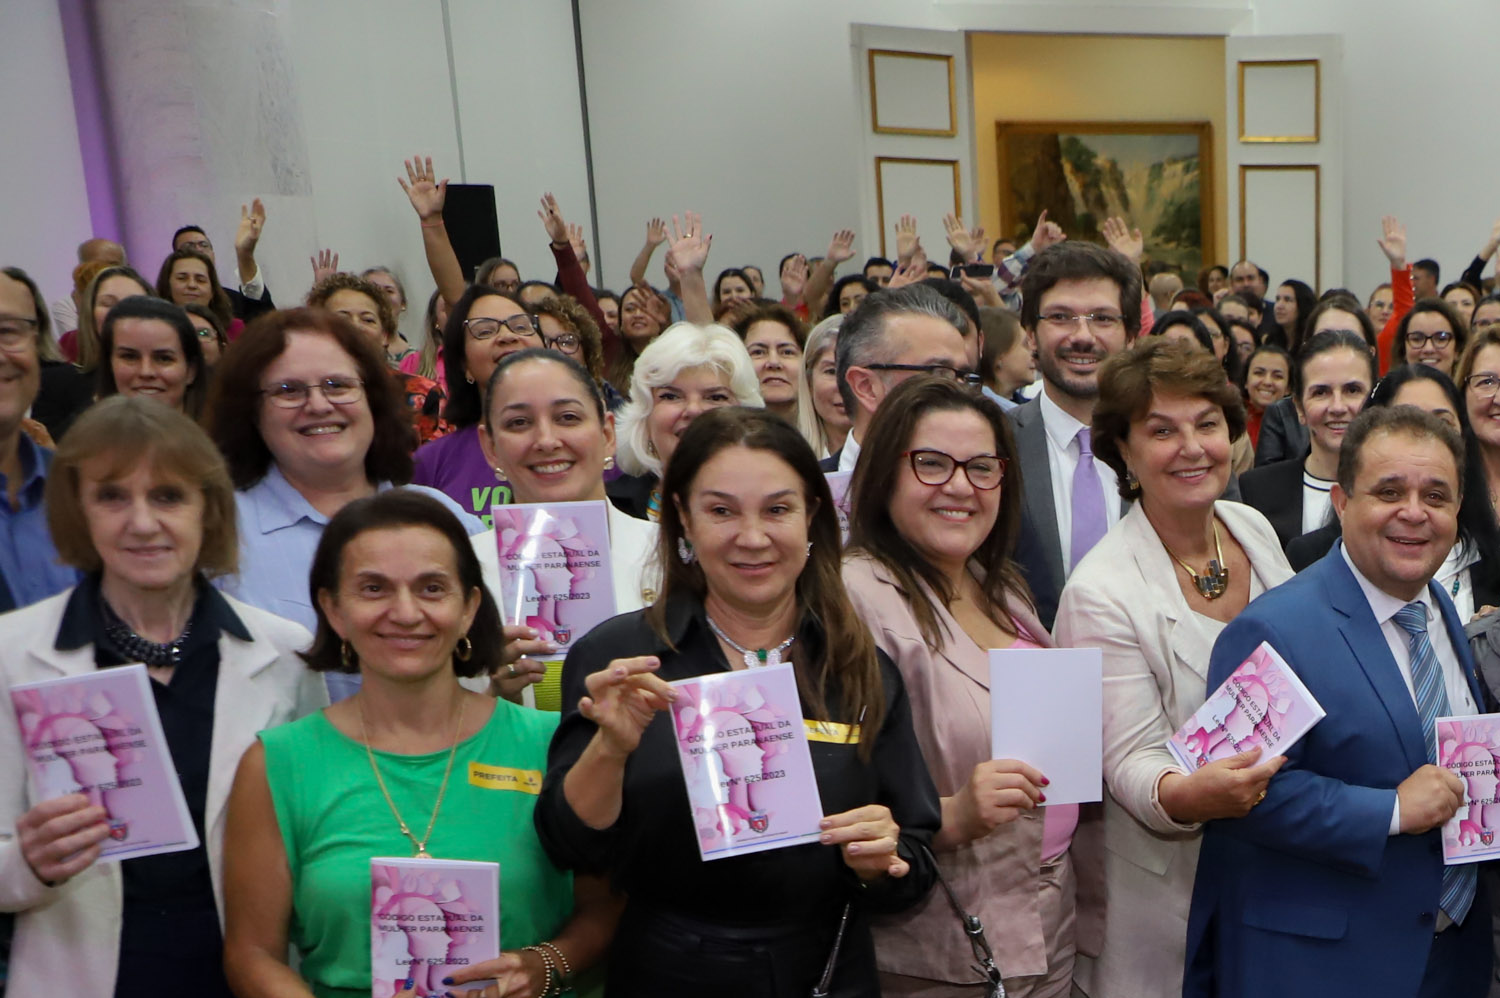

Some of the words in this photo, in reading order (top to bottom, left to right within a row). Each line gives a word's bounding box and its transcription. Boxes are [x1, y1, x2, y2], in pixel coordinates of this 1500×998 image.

[545, 561, 600, 569] PARANAENSE
[1226, 684, 1246, 710] MULHER
[1244, 708, 1275, 749] PARANAENSE
[1249, 700, 1274, 734] ESTADUAL
[1272, 731, 1281, 742] DA
[727, 723, 776, 737] ESTADUAL
[778, 720, 791, 728] DA
[731, 732, 795, 749] PARANAENSE
[473, 771, 518, 782] PREFEITA
